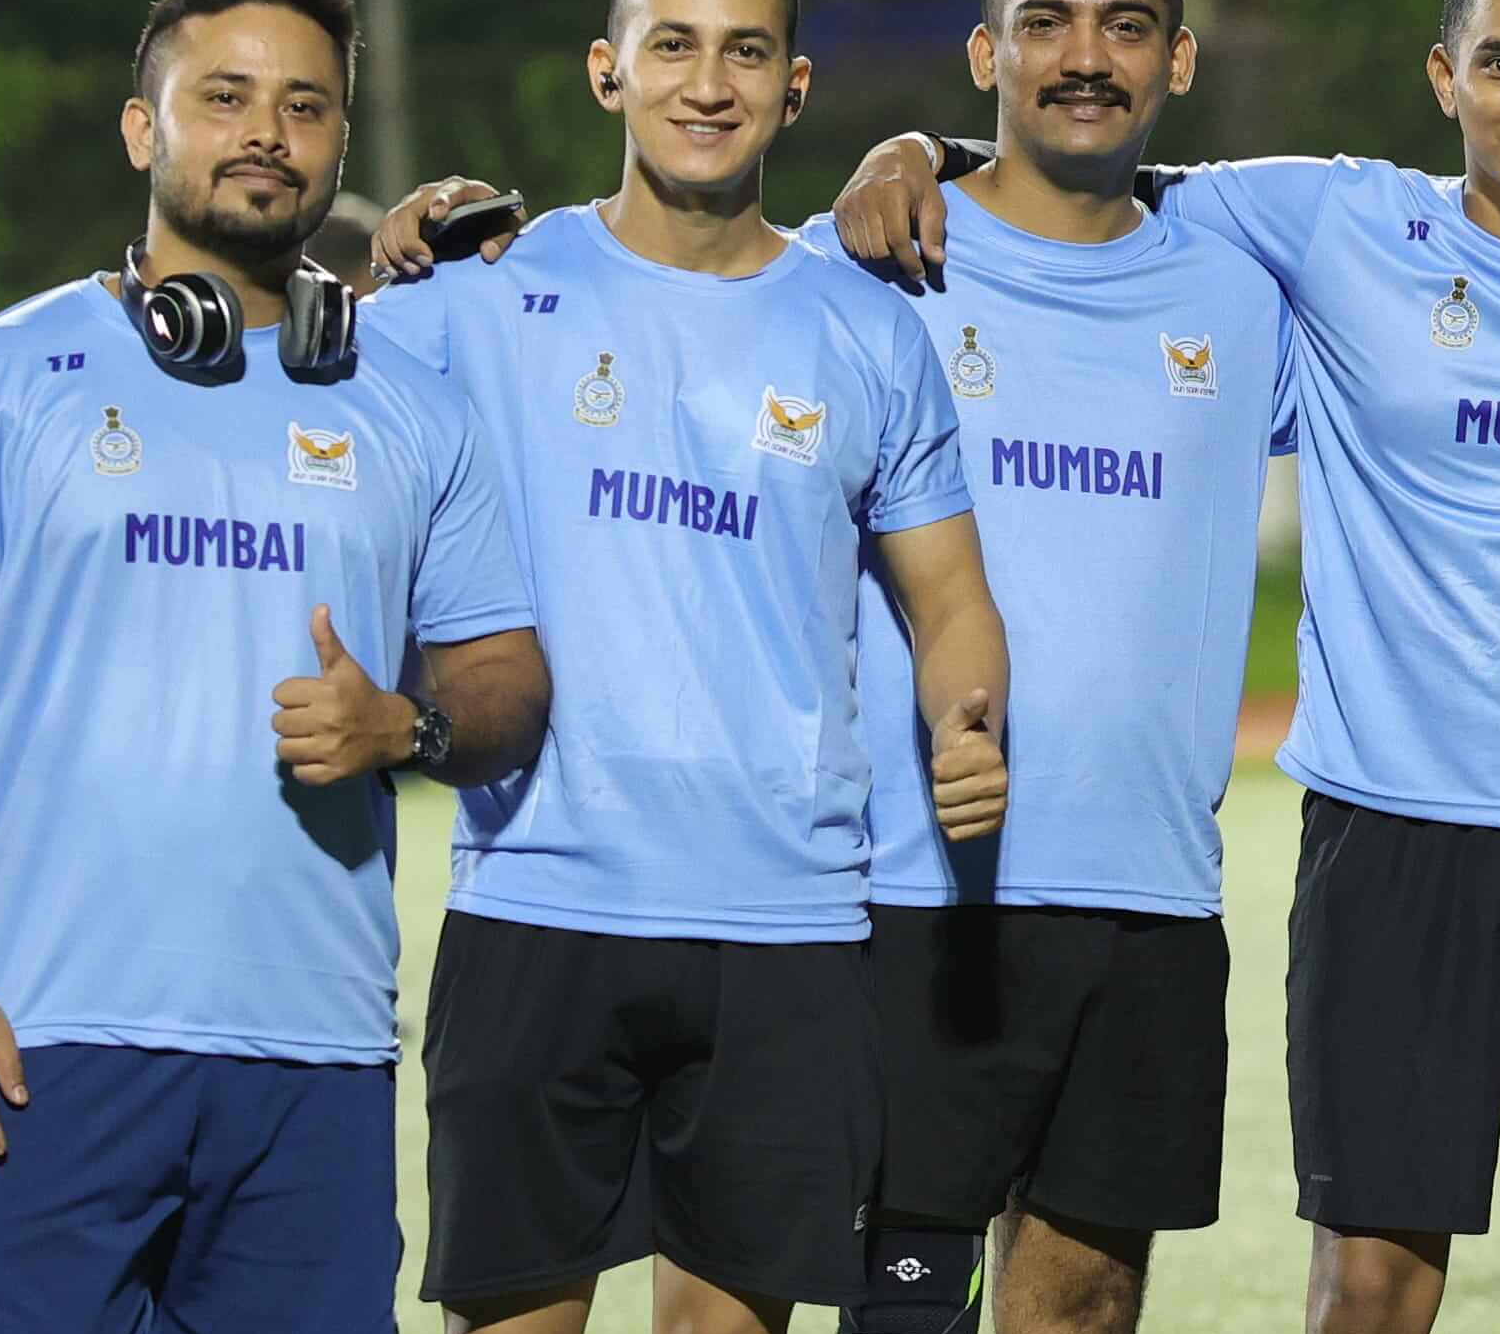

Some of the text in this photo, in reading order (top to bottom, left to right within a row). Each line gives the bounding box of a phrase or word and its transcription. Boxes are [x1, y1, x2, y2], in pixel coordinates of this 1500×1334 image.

[992, 438, 1162, 499] MUMBAI
[588, 468, 758, 540] MUMBAI
[124, 513, 305, 572] MUMBAI
